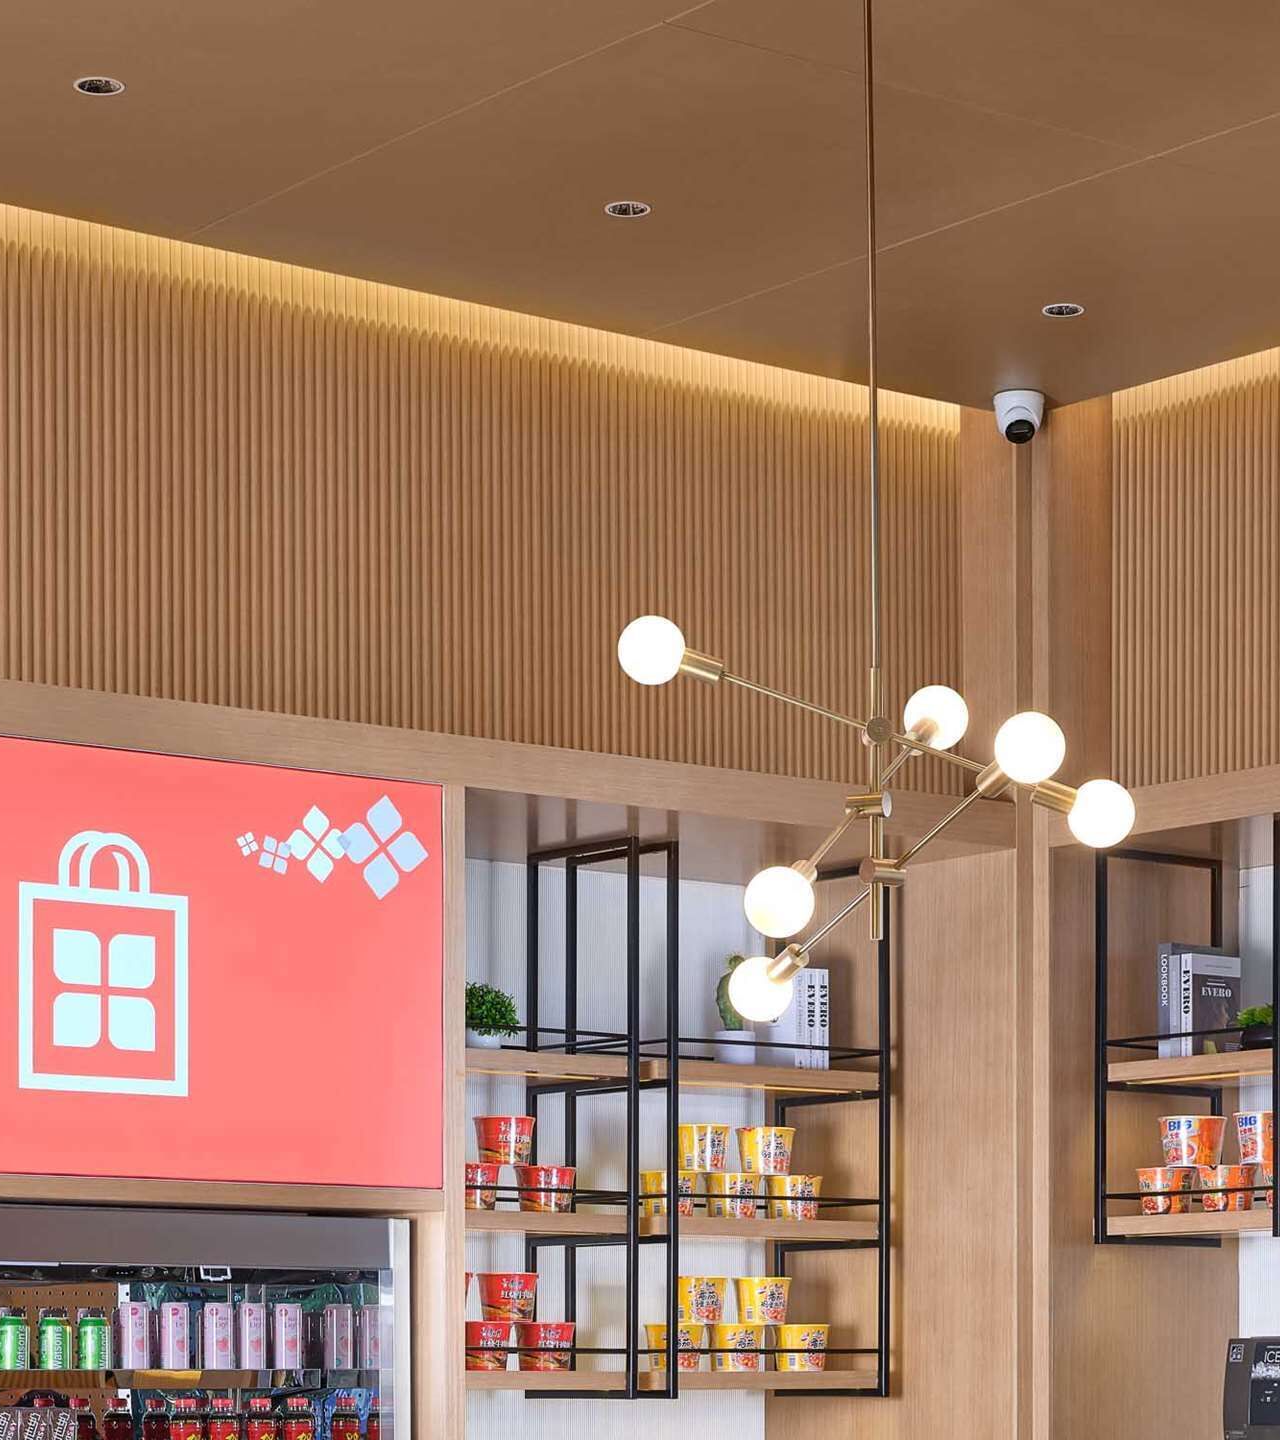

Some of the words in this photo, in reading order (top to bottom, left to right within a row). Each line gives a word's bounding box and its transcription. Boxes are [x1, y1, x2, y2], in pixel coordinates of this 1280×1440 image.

[1202, 986, 1232, 998] EVERO
[1168, 1120, 1192, 1132] BIG
[1238, 1115, 1257, 1128] BIG
